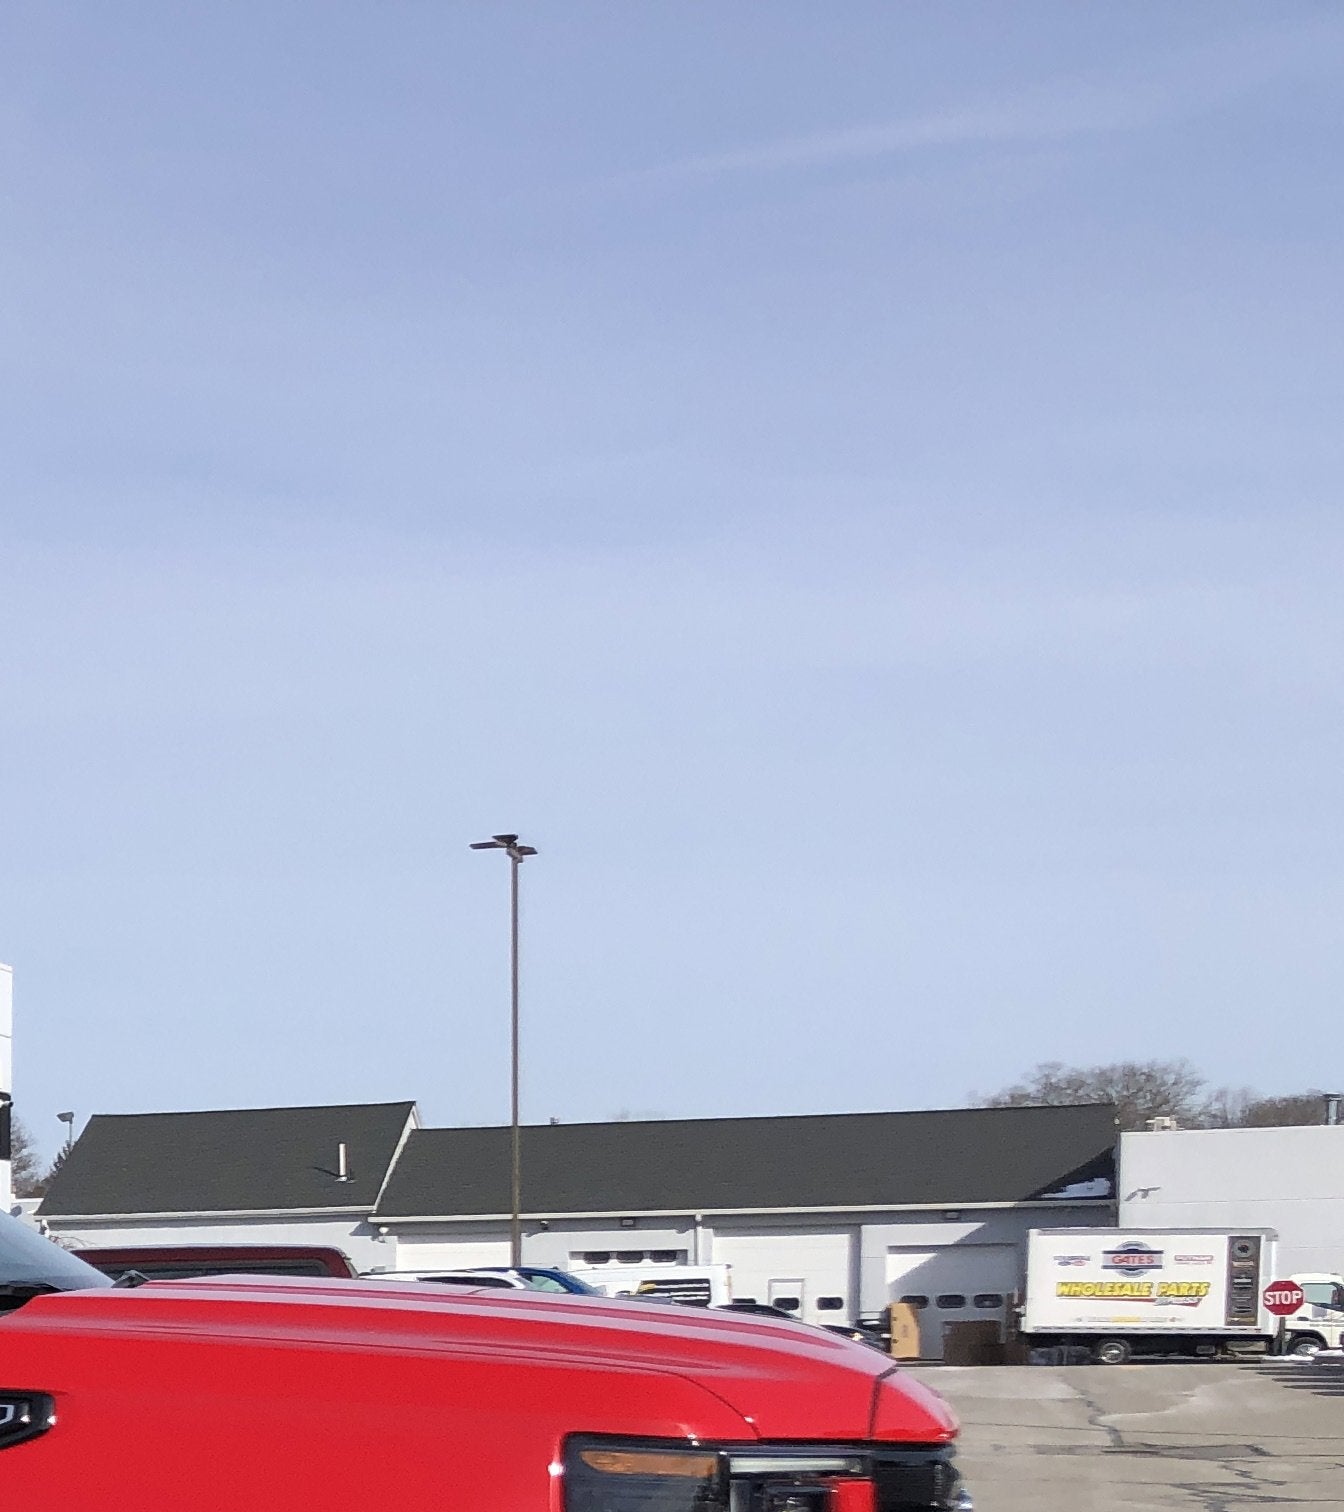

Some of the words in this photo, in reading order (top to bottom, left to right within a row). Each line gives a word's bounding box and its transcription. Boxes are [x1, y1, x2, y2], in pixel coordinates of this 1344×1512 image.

[1112, 1254, 1155, 1265] GATES
[1056, 1282, 1153, 1297] WHOLESALE
[1155, 1282, 1211, 1297] PARTS
[1264, 1290, 1302, 1306] STOP
